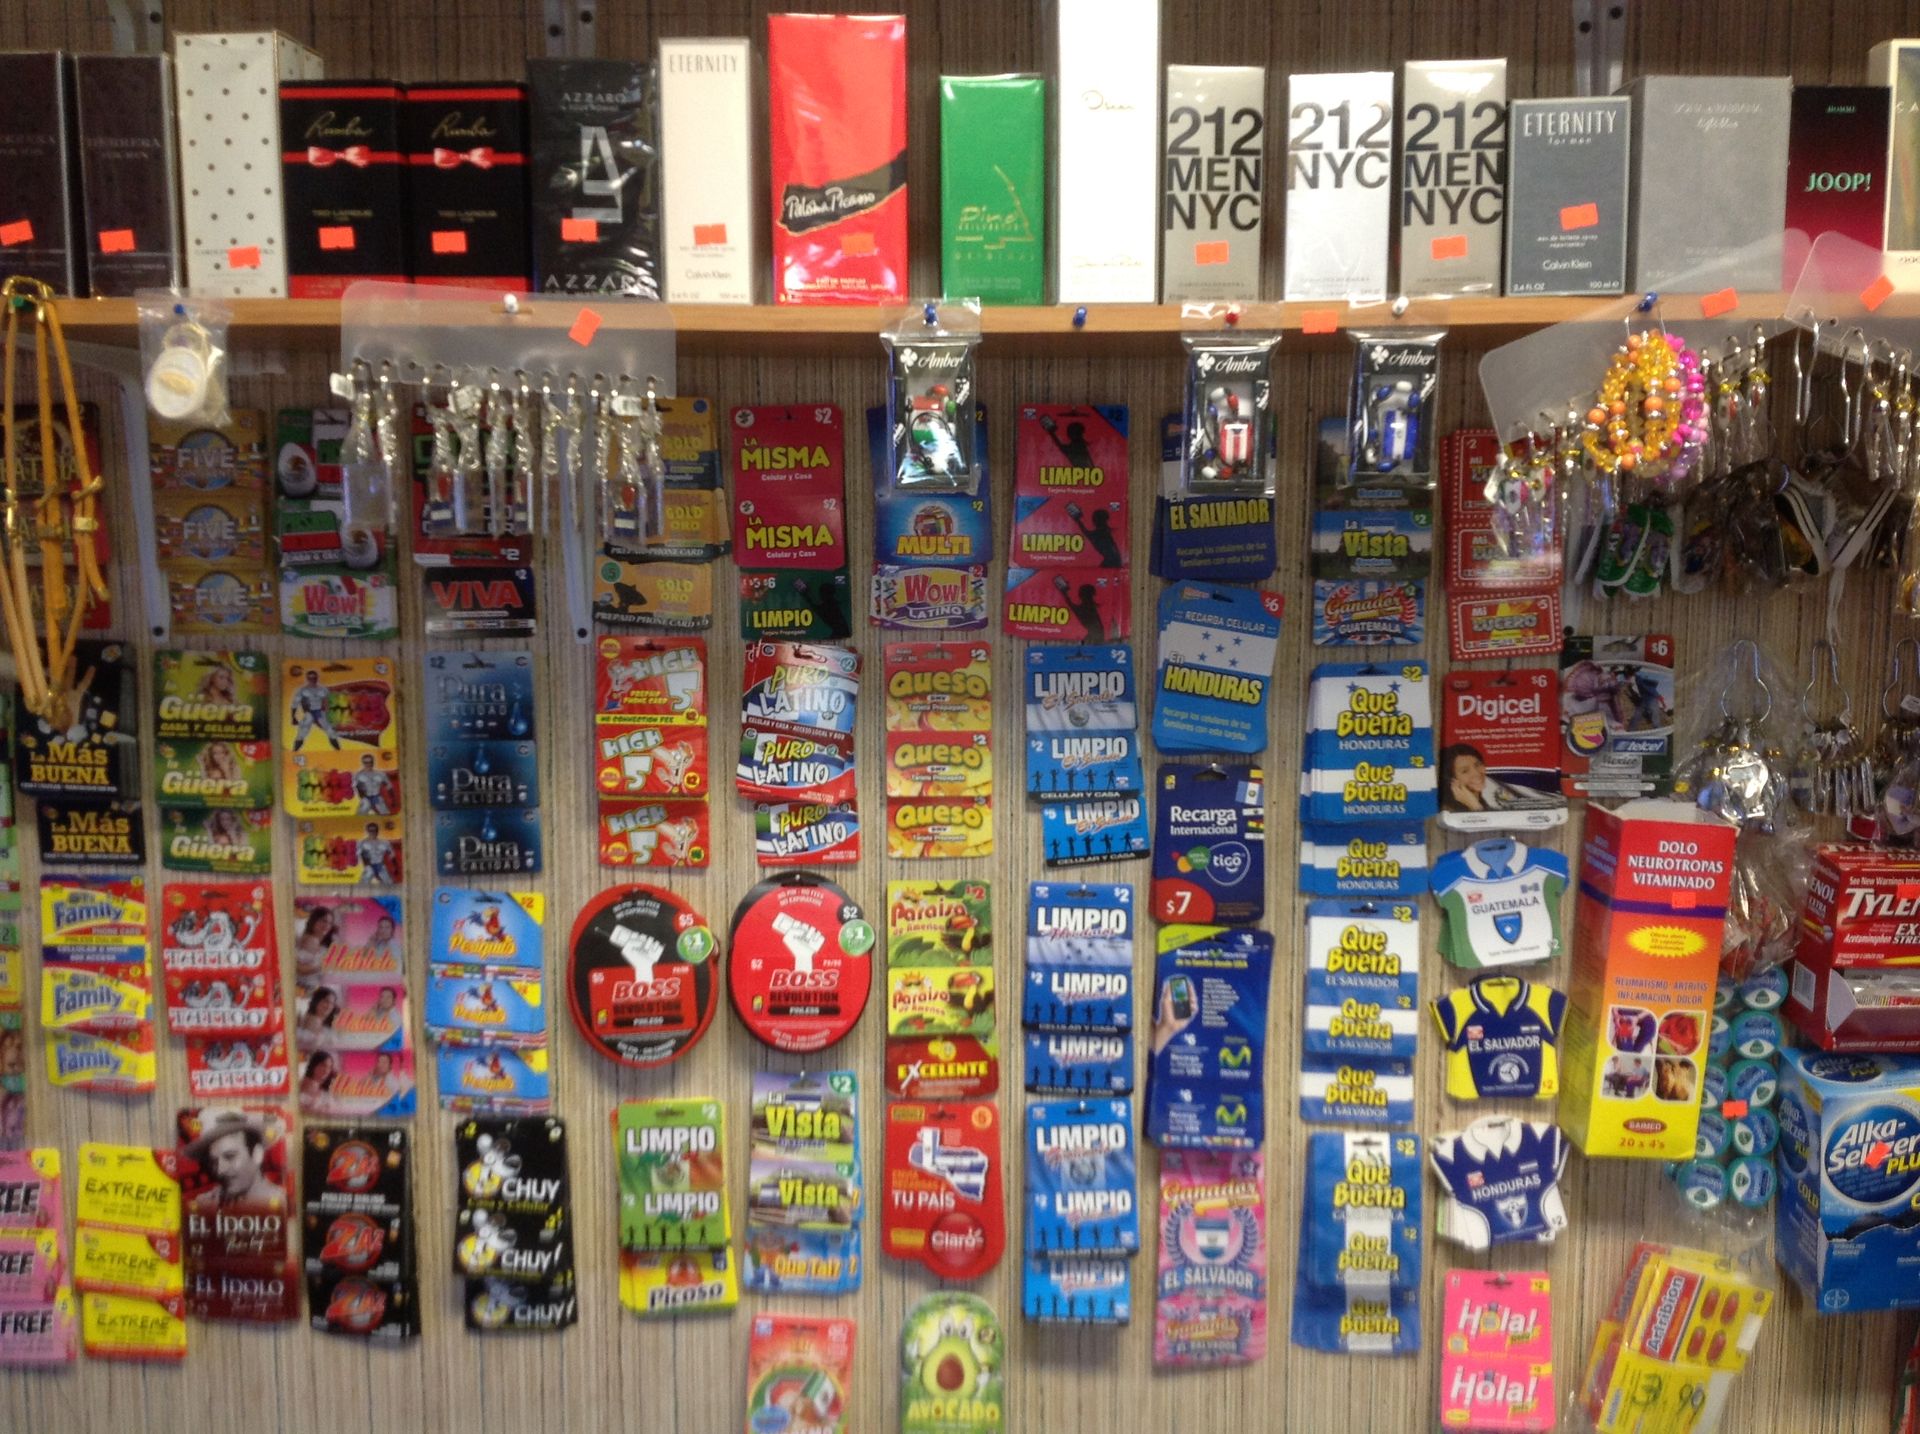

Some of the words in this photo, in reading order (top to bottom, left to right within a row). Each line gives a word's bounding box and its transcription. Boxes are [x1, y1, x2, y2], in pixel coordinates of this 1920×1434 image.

[669, 55, 738, 73] ETERNITY
[1168, 106, 1263, 156] 212
[1289, 100, 1393, 150] 212
[1406, 100, 1507, 150] 212
[1523, 110, 1617, 137] ETERNITY
[1167, 158, 1262, 192] MEN
[1287, 150, 1390, 190] NYC
[1405, 151, 1506, 188] MEN
[1805, 172, 1872, 192] JOOP!
[827, 188, 875, 213] Picasso
[1403, 187, 1504, 226] NYC
[1165, 194, 1261, 231] NYC
[1571, 260, 1592, 270] Klein
[918, 352, 963, 369] Amber
[1215, 356, 1260, 372] Amber
[1389, 350, 1435, 366] Amber
[178, 448, 235, 468] FIVE
[741, 446, 831, 471] MISMA
[1040, 467, 1103, 486] LIMPIO
[746, 525, 834, 549] MISMA
[897, 536, 970, 555] MULTI
[1022, 534, 1083, 552] LIMPIO
[1343, 531, 1408, 558] Vista
[432, 580, 522, 608] VIVA
[904, 575, 967, 603] Wow!
[1265, 598, 1279, 612] $6
[1338, 622, 1401, 635] GUATEMALA
[971, 649, 987, 661] $2
[1111, 649, 1127, 664] $2
[1652, 640, 1668, 657] $6
[630, 648, 699, 681] HIGH
[771, 665, 829, 693] PURO
[889, 671, 989, 698] Queso
[1034, 671, 1126, 699] LIMPIO
[1163, 665, 1263, 705] HONDURAS
[1531, 675, 1548, 688] $6
[665, 671, 699, 712] 5
[760, 688, 846, 716] LATINO
[1350, 688, 1398, 714] Que
[1458, 693, 1540, 721] Digicel
[1337, 711, 1413, 737] Buena
[1511, 715, 1549, 724] salvador
[601, 728, 663, 760] HIGH
[973, 734, 987, 745] $2
[1031, 740, 1044, 753] $2
[1339, 739, 1410, 751] HONDURAS
[1627, 740, 1665, 753] telcel
[763, 740, 816, 766] PURO
[894, 743, 983, 768] Queso
[31, 765, 110, 785] BUENA
[452, 767, 511, 792] Pura
[622, 755, 653, 790] 5
[752, 761, 830, 786] LATINO
[1354, 762, 1394, 784] Que
[1095, 791, 1120, 799] CASA
[1343, 782, 1407, 804] Buena
[606, 805, 667, 835] HIGH
[779, 804, 829, 830] PURO
[895, 804, 983, 830] Queso
[1170, 807, 1238, 824] Recarga
[1343, 804, 1406, 815] HONDURAS
[771, 822, 848, 857] LATINO
[1170, 824, 1237, 836] Internacional
[52, 834, 132, 853] BUENA
[459, 835, 519, 859] Pura
[627, 830, 658, 864] 5
[1348, 839, 1388, 860] Que
[1659, 840, 1698, 855] DOLO
[1057, 855, 1100, 864] CELULAR
[1110, 852, 1135, 861] CASA
[1337, 858, 1400, 879] Buena
[1628, 855, 1724, 874] NEUROTROPAS
[1337, 879, 1400, 890] HONDURAS
[1632, 871, 1716, 890] VITAMINADO
[1861, 877, 1875, 885] New
[1876, 878, 1904, 886] Warnings
[843, 906, 858, 919] $2
[1166, 890, 1193, 916] $7
[1472, 896, 1541, 915] GUATEMALA
[54, 902, 124, 929] Family
[679, 914, 694, 927] $5
[1843, 933, 1892, 945] Acetaminophen
[165, 949, 264, 969] TATTOO
[1327, 947, 1401, 976] Buena
[612, 977, 683, 1002] BOSS
[769, 968, 840, 990] BOSS
[1051, 972, 1127, 995] LIMPIO
[1326, 977, 1336, 986] EL
[1336, 977, 1399, 988] SALVADOR
[55, 984, 124, 1017] Family
[1342, 998, 1381, 1019] Que
[1677, 993, 1703, 1004] DOLOR
[169, 1008, 267, 1027] TATTOO
[1328, 1017, 1393, 1040] Buena
[1336, 1040, 1393, 1050] SALVADOR
[1468, 1039, 1482, 1050] EL
[1483, 1036, 1541, 1050] SALVADOR
[57, 1046, 123, 1077] Family
[192, 1069, 287, 1090] TATTOO
[898, 1060, 988, 1089] EXCELENTE
[1337, 1066, 1376, 1087] Que
[766, 1107, 841, 1139] Vista
[1834, 1119, 1907, 1149] Alka-
[626, 1126, 715, 1154] LIMPIO
[1036, 1125, 1125, 1152] LIMPIO
[1619, 1137, 1635, 1147] 20
[1638, 1139, 1646, 1148] x
[1649, 1137, 1665, 1149] 4's
[1346, 1160, 1391, 1185] Que
[85, 1179, 173, 1204] EXTREME
[502, 1178, 560, 1201] CHUY
[779, 1180, 839, 1209] Vista
[893, 1191, 914, 1208] TU
[918, 1186, 955, 1210] PAÍS
[1472, 1173, 1542, 1201] HONDURAS
[1797, 1181, 1819, 1209] COLD
[645, 1192, 719, 1216] LIMPIO
[1056, 1190, 1131, 1215] LIMPIO
[931, 1228, 976, 1248] Claro
[1350, 1232, 1388, 1252] Que
[84, 1250, 161, 1273] EXTREME
[1338, 1251, 1399, 1272] Buena
[1165, 1273, 1178, 1288] EL
[1185, 1268, 1254, 1288] SALVADOR
[649, 1284, 725, 1311] Picoso
[97, 1313, 171, 1332] EXTREME
[1646, 1275, 1684, 1353] Artribion
[907, 1400, 999, 1422] AVOCADO
